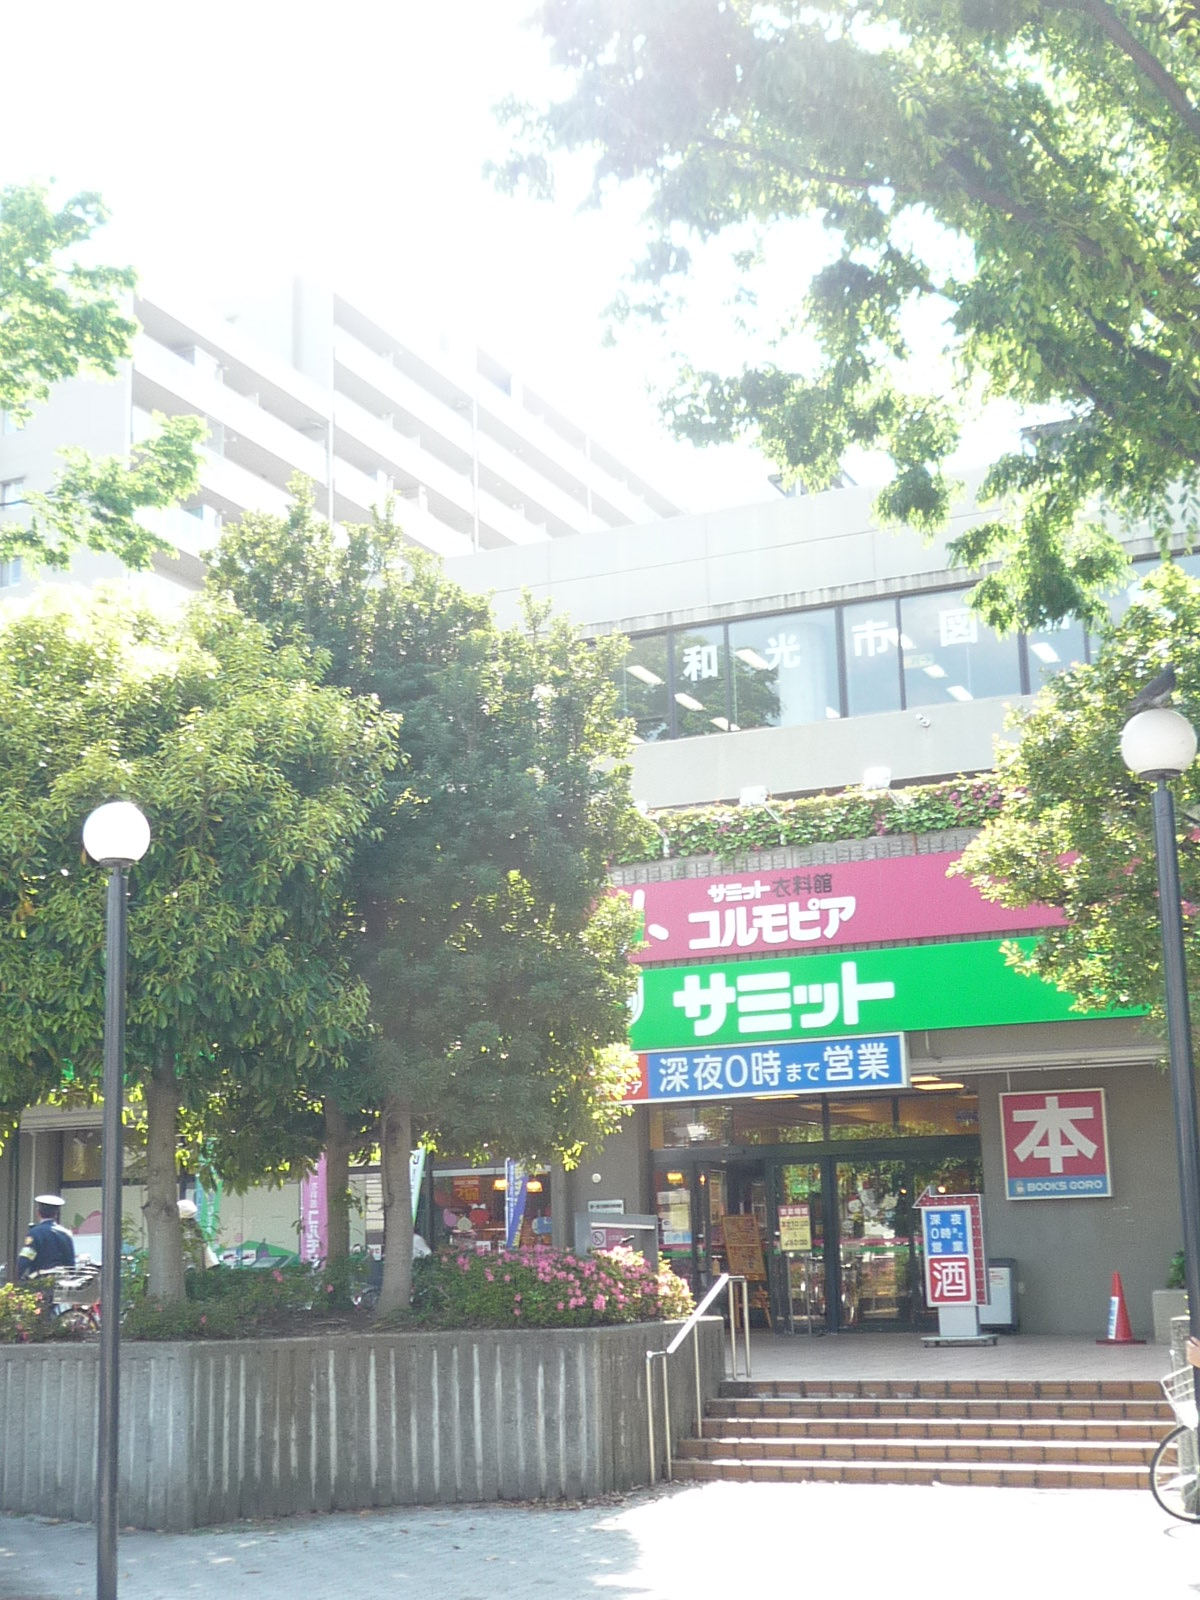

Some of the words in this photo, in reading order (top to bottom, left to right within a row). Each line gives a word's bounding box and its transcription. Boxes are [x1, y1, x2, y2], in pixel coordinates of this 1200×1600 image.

[688, 896, 857, 950] コルモピア
[672, 961, 896, 1037] サミット
[658, 1042, 890, 1093] 深夜0時まで営業
[1012, 1096, 1098, 1174] 本
[1027, 1181, 1067, 1192] BOOKS
[1069, 1180, 1103, 1190] GORO
[932, 1261, 968, 1298] 酒
